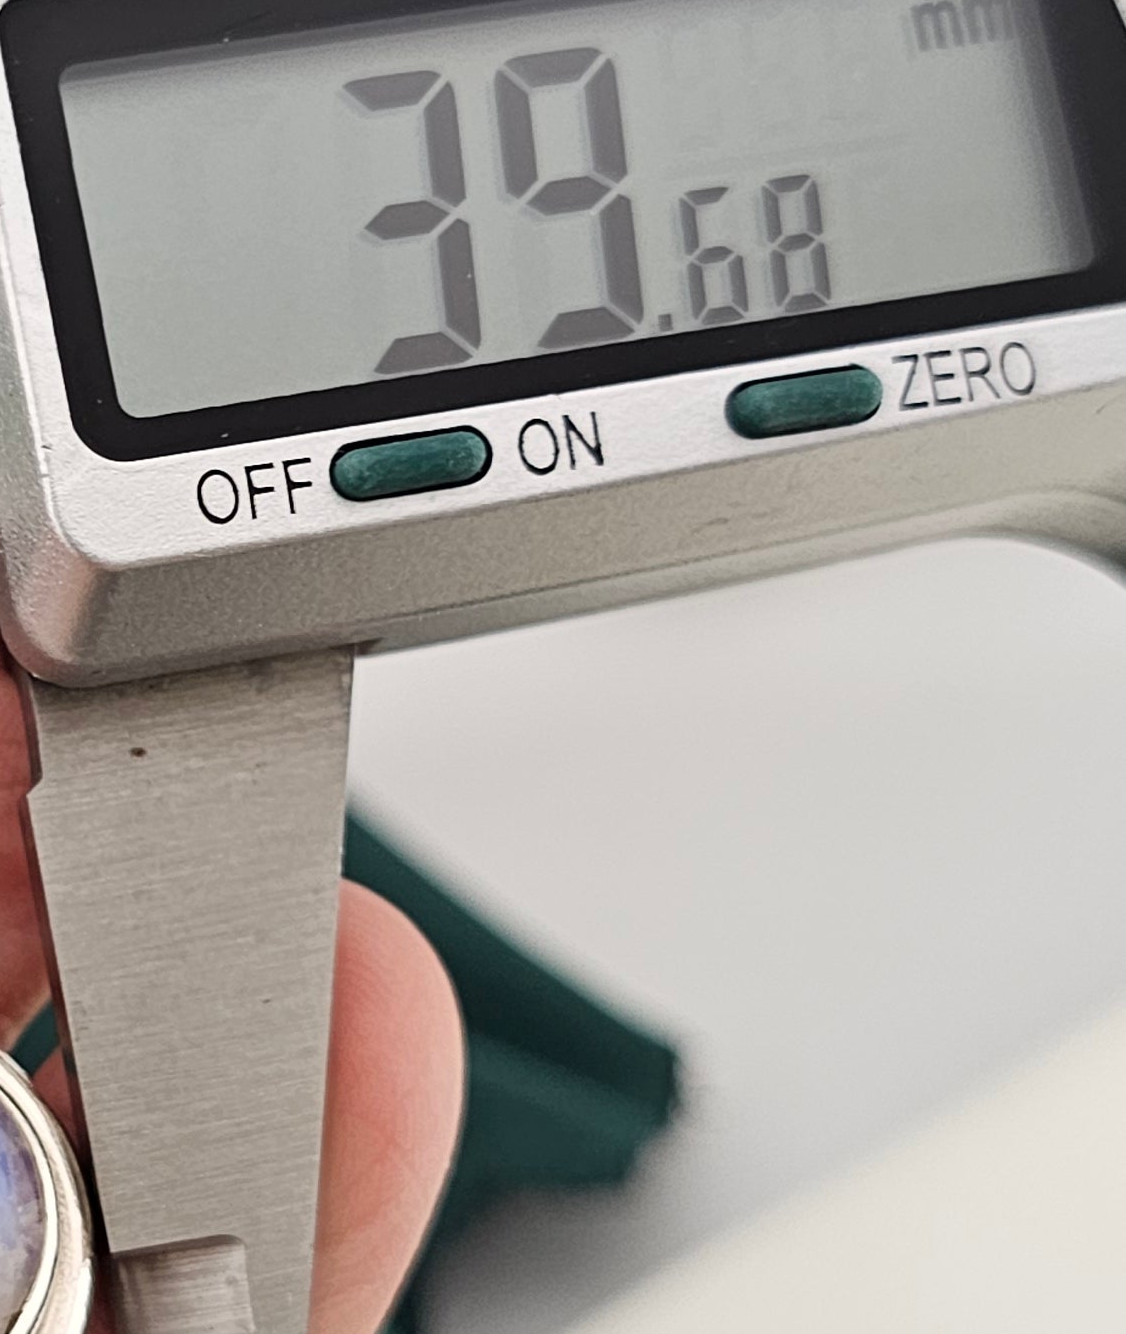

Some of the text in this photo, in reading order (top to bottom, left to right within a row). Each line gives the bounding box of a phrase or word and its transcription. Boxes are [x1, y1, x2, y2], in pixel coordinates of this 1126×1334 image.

[341, 46, 833, 375] 39.68
[890, 341, 1038, 411] ZERO
[195, 412, 605, 525] OFF ON
